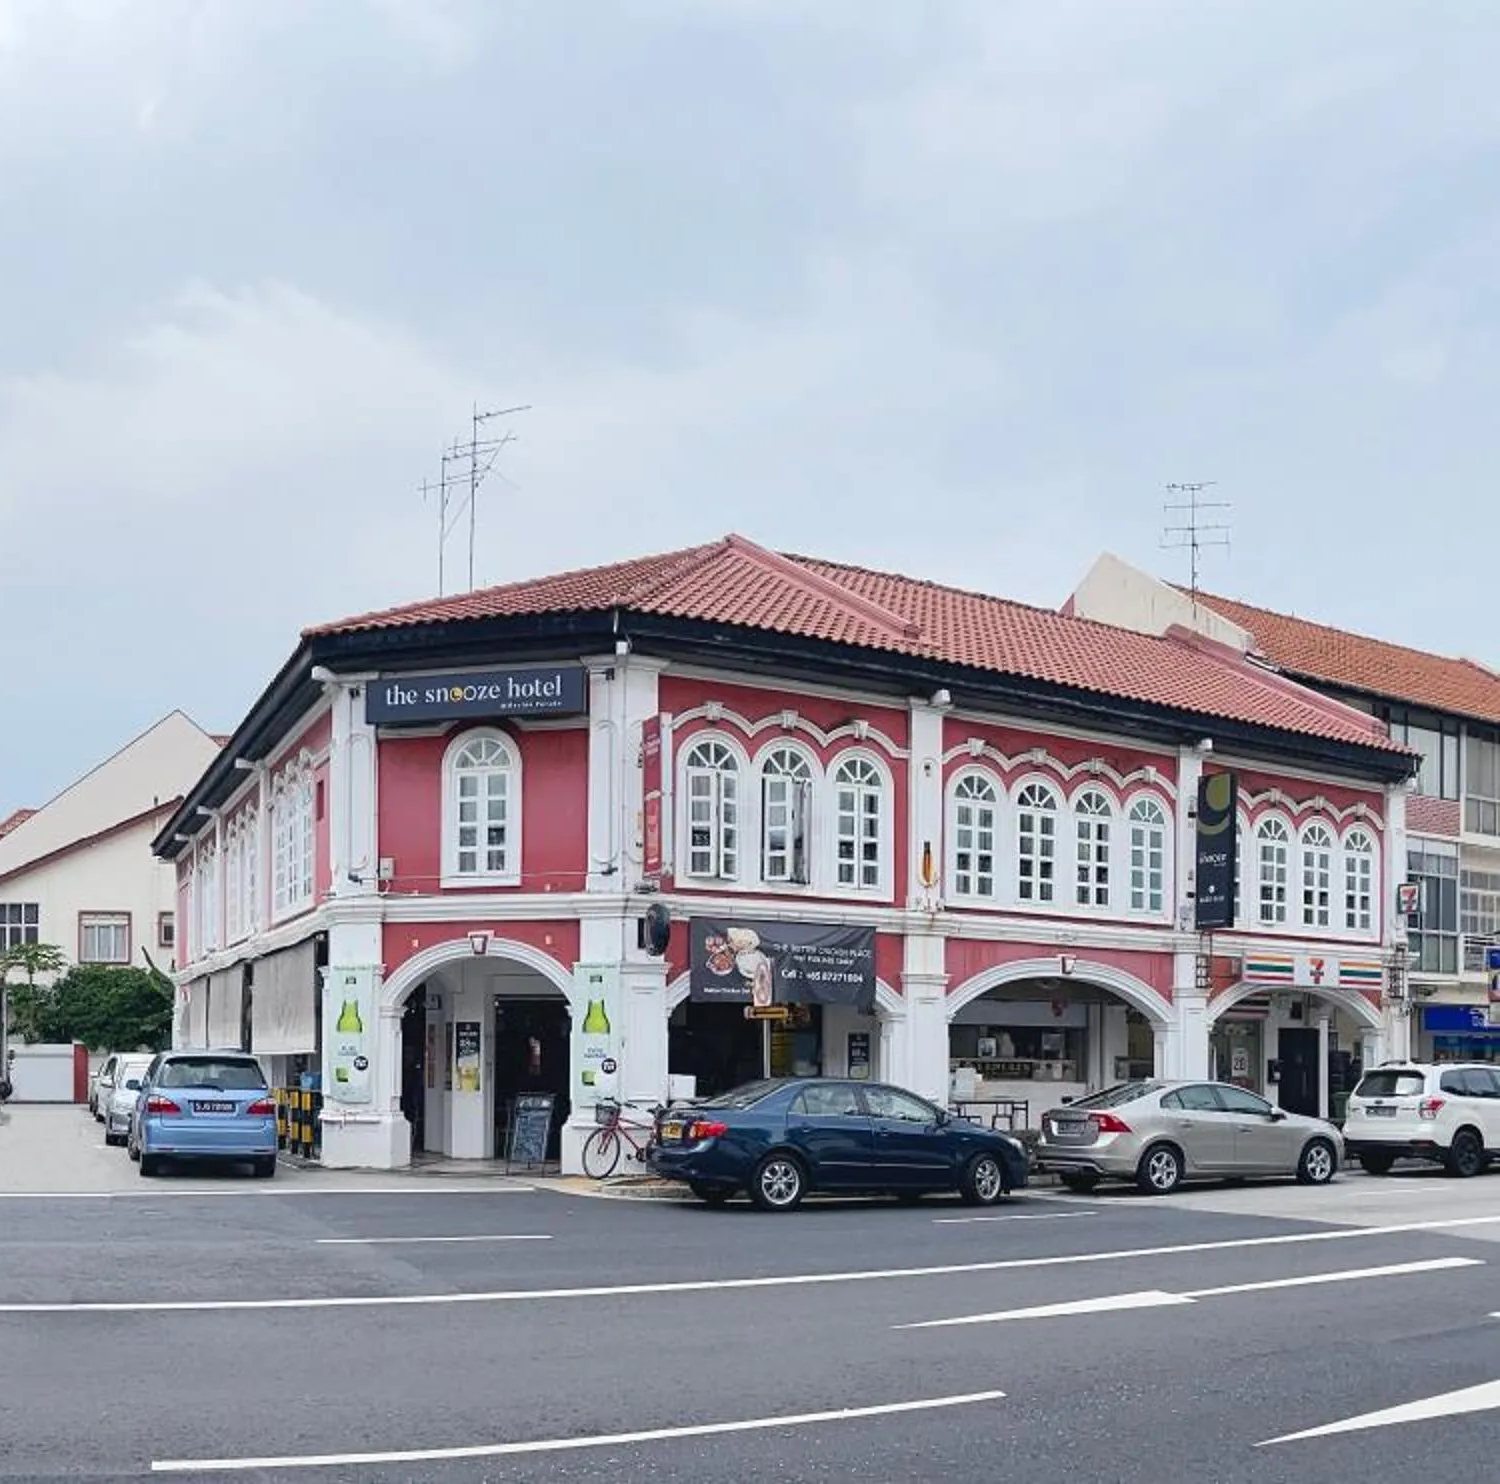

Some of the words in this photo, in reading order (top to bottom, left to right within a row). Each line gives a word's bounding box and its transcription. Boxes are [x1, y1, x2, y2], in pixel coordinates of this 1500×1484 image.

[386, 684, 418, 706] the
[425, 684, 501, 703] snooze
[507, 675, 562, 698] hotel
